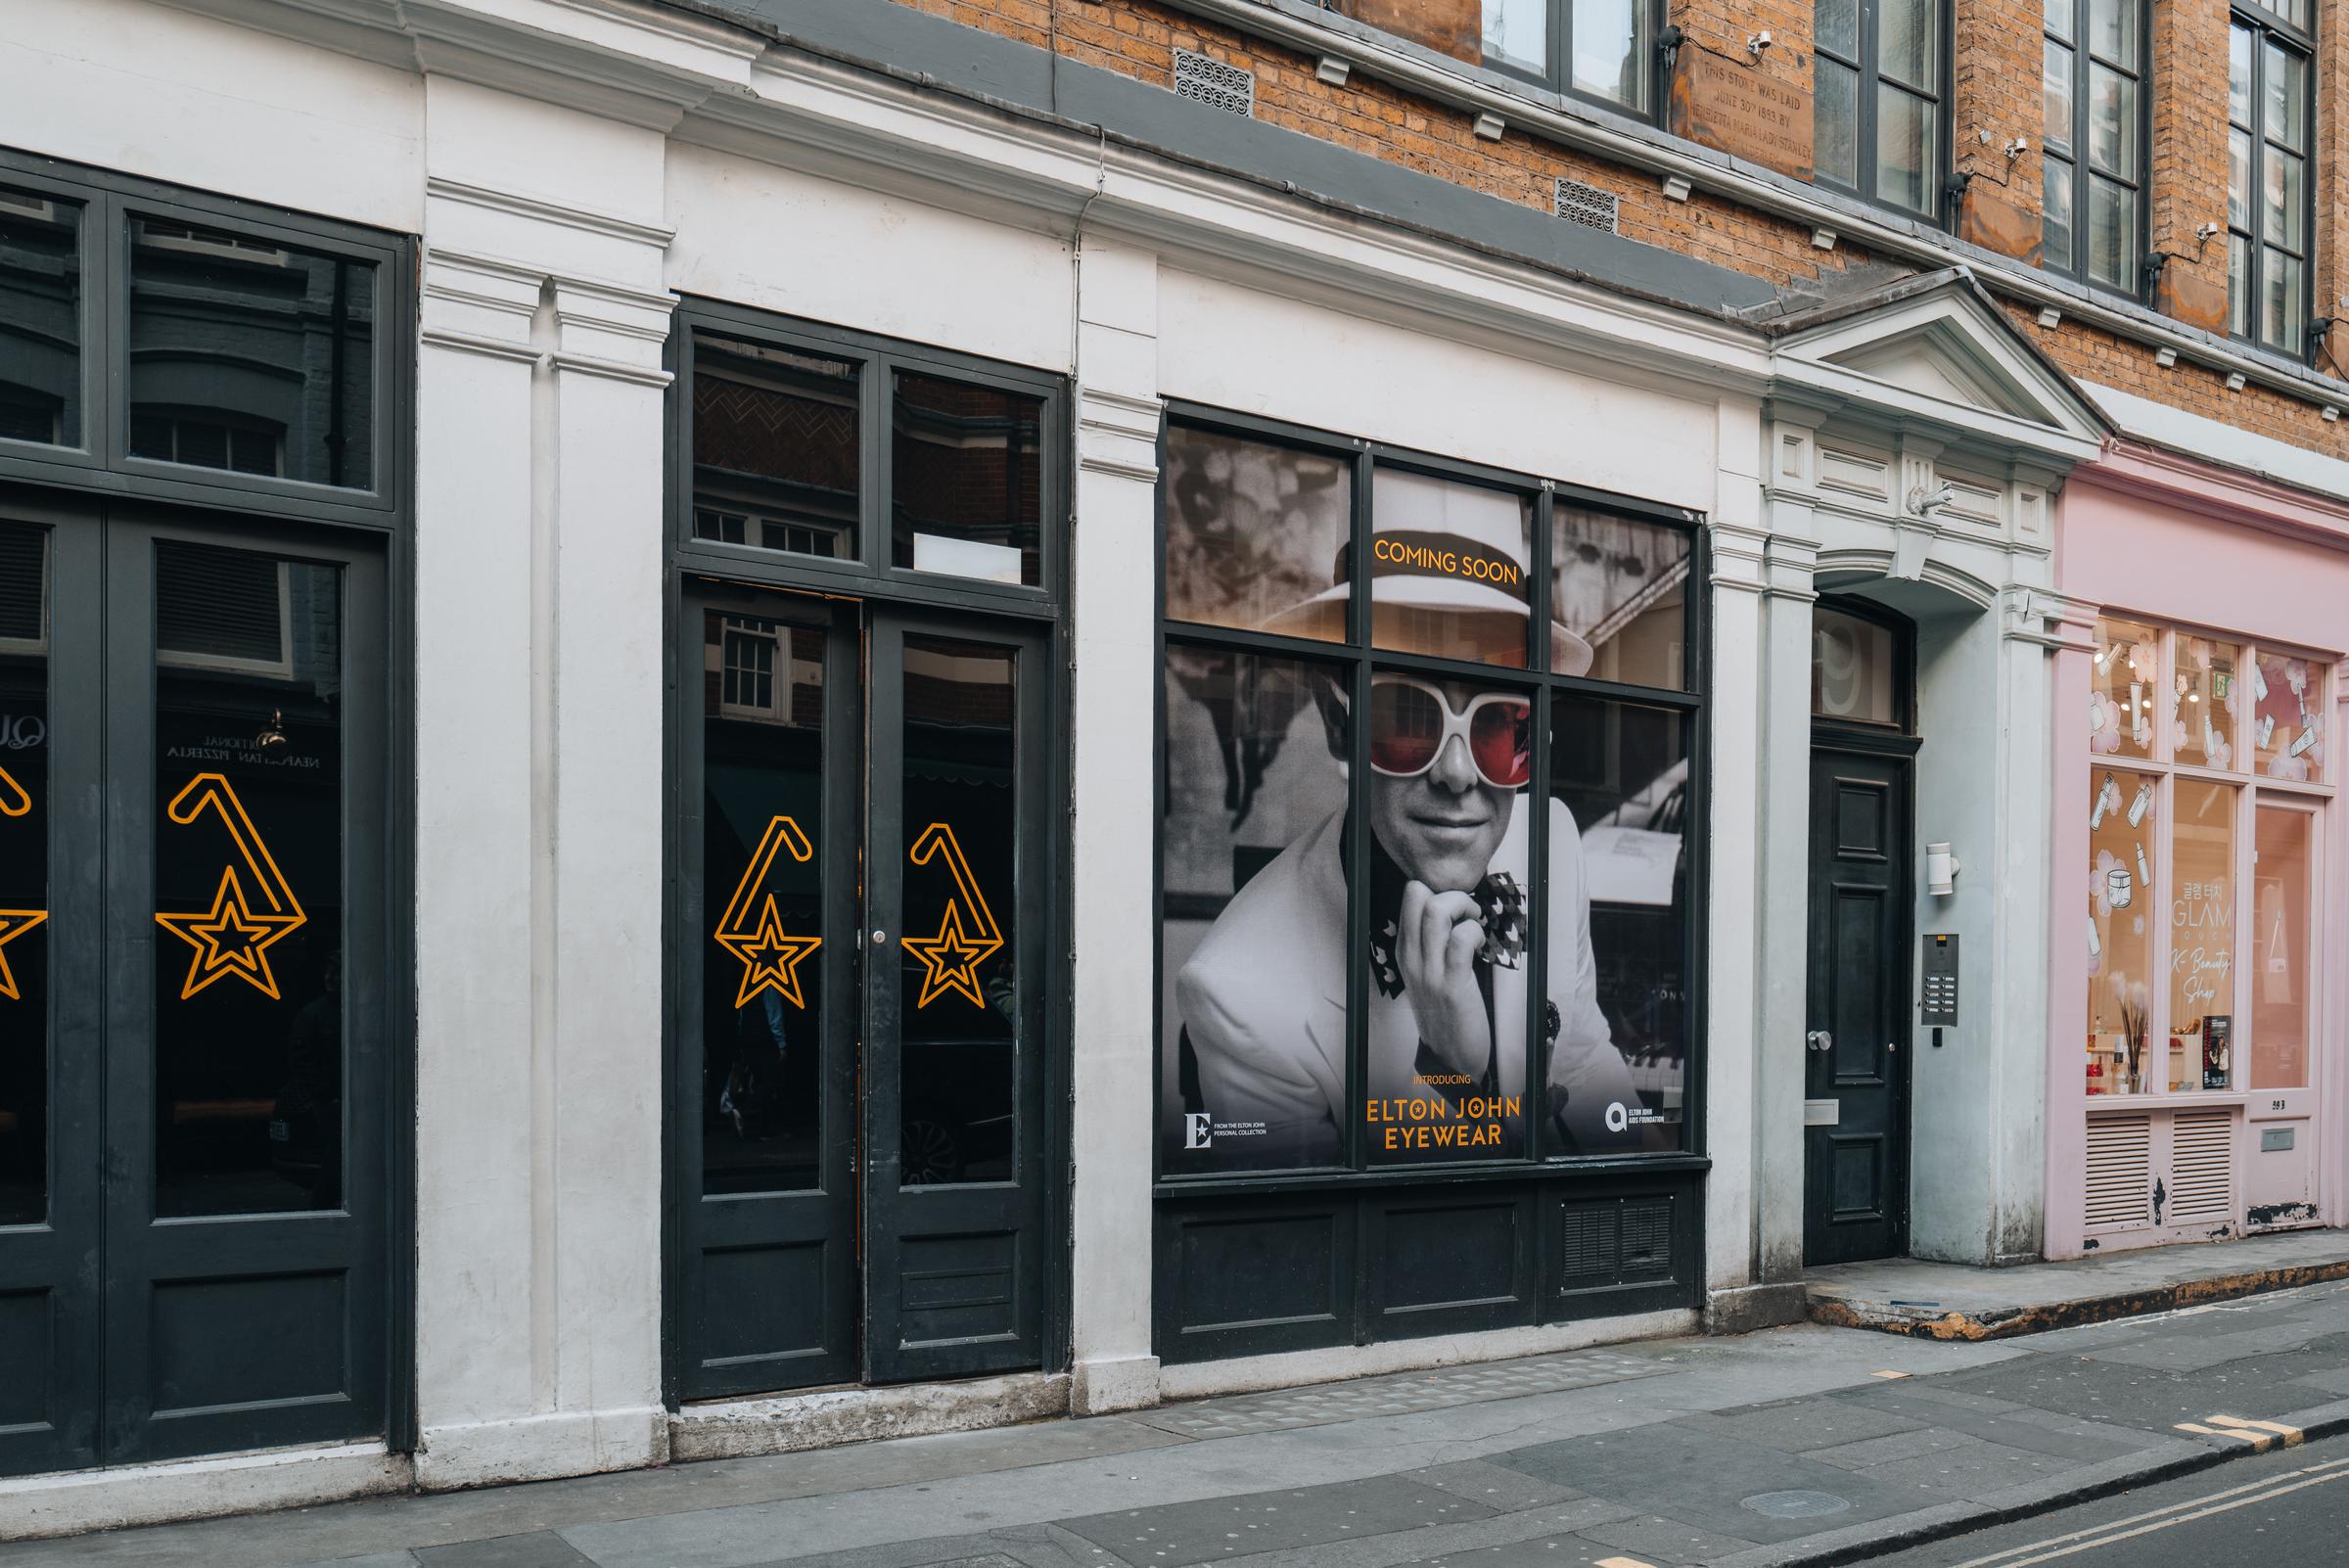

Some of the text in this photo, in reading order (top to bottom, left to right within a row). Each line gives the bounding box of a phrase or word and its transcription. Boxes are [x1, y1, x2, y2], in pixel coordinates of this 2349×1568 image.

[1715, 89, 1736, 108] JUNE
[1779, 114, 1790, 128] BY
[1758, 82, 1776, 101] WAS
[1780, 92, 1800, 110] LAID
[1779, 136, 1812, 160] STANLEY
[1374, 539, 1518, 585] COMING SOON
[2172, 899, 2232, 928] GLAM
[1413, 1074, 1471, 1085] INTRODUCING
[1367, 1096, 1520, 1122] ELTON JOHN
[1629, 1108, 1641, 1117] ELTON
[1385, 1124, 1501, 1149] EYEWEAR
